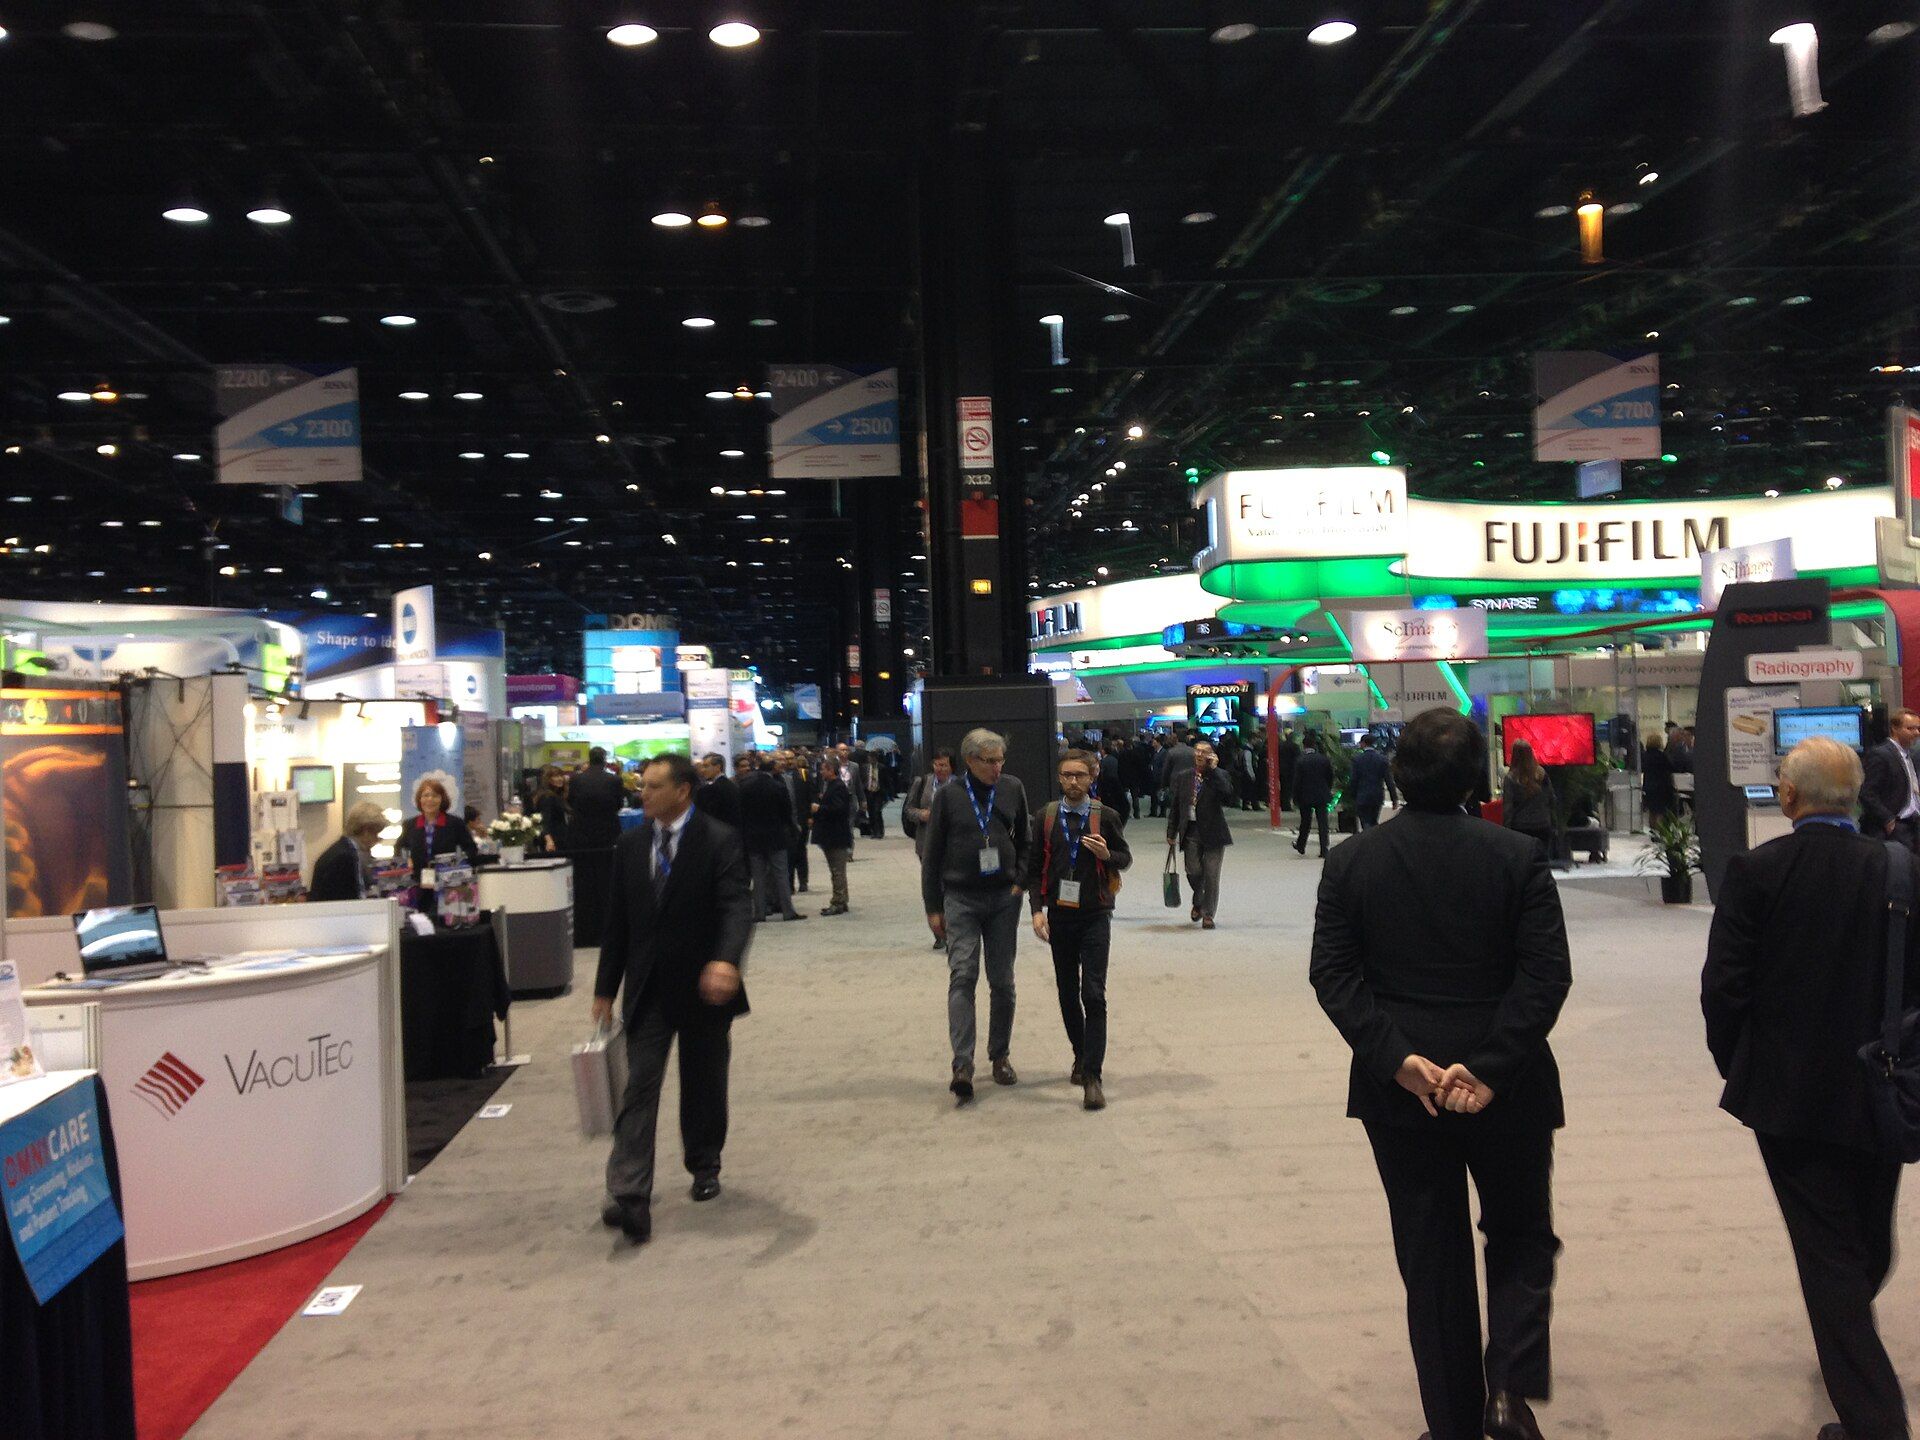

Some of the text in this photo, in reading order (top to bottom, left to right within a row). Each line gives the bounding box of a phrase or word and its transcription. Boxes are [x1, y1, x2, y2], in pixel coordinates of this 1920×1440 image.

[222, 369, 271, 388] 2200
[772, 369, 820, 388] 2400
[1611, 401, 1655, 420] 2700
[304, 419, 353, 439] 2300
[850, 416, 894, 436] 2500
[1240, 489, 1394, 521] FUIFILM
[1484, 516, 1730, 564] FUJIFILM
[1471, 597, 1538, 610] SYNAPSE
[316, 631, 359, 649] Shape
[363, 635, 377, 647] to
[1755, 659, 1855, 677] Radiography
